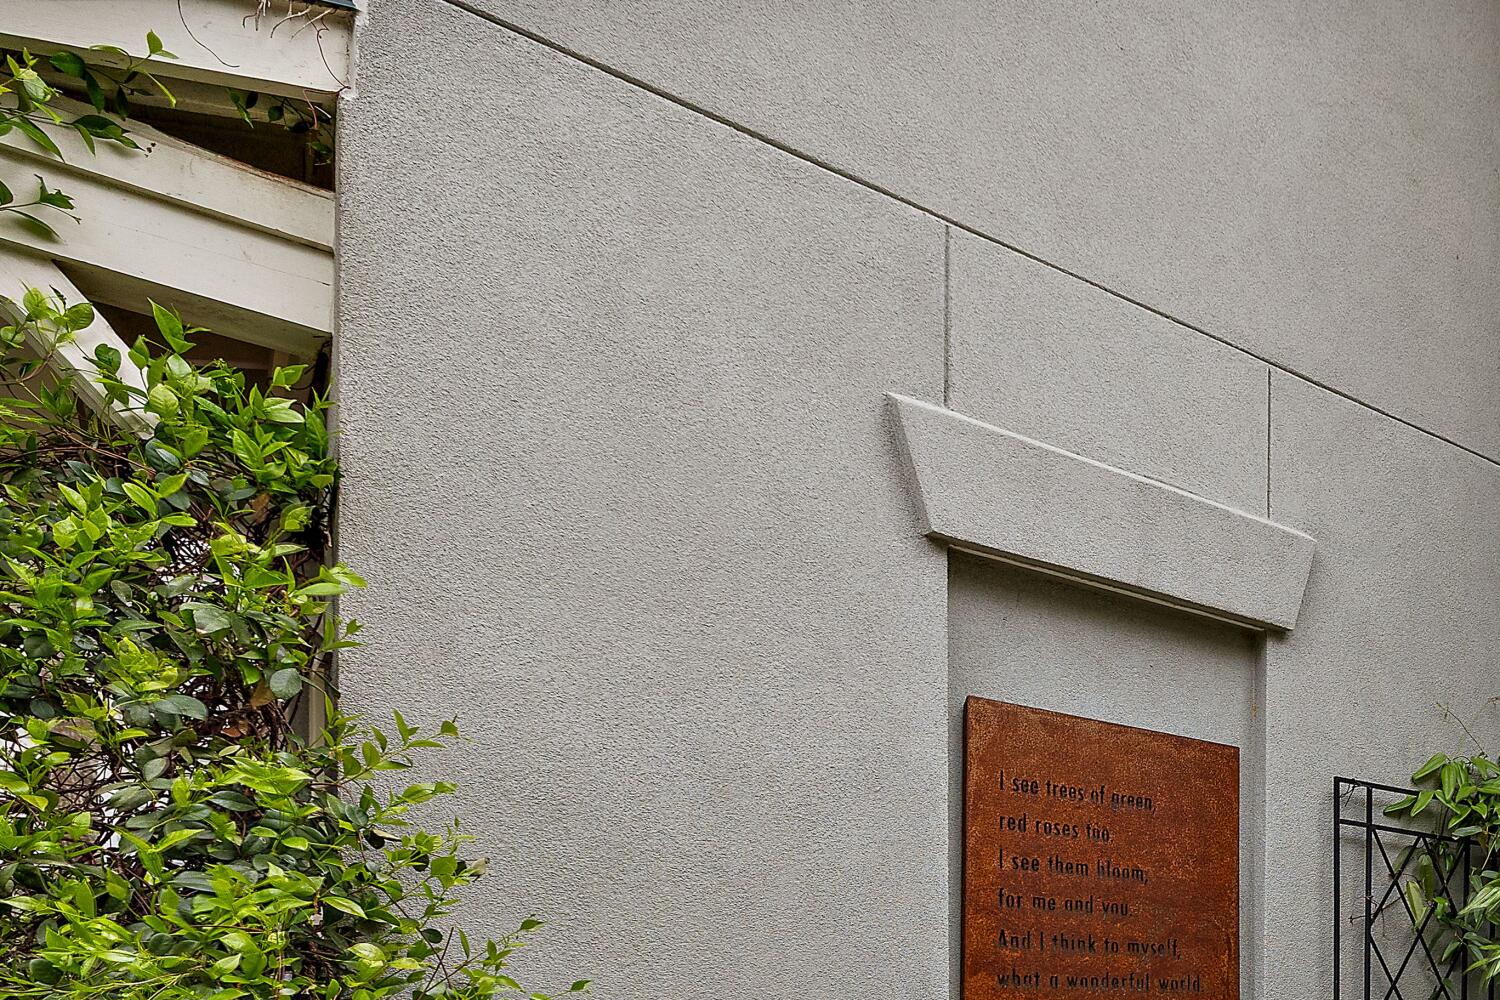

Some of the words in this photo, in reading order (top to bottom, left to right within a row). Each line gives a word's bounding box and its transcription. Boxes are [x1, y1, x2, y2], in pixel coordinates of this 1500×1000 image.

[1000, 769, 1004, 791] I
[1012, 776, 1039, 796] see
[1046, 779, 1085, 801] trees
[1090, 785, 1106, 802] of
[1111, 792, 1157, 814] green,
[1000, 813, 1027, 833] red
[1035, 819, 1079, 839] roses
[998, 849, 1003, 871] I
[1012, 855, 1040, 872] see
[1047, 856, 1089, 877] them
[1097, 859, 1150, 885] bloom,
[998, 888, 1022, 910] for
[1032, 895, 1056, 912] me
[1064, 894, 1094, 914] and
[998, 928, 1031, 949] And
[1040, 931, 1044, 951] I
[1052, 931, 1097, 953] think
[1104, 937, 1120, 954] to
[1127, 938, 1183, 961] myself,
[996, 967, 1041, 989] what
[1049, 974, 1059, 989] a
[1066, 971, 1150, 993] wonderful
